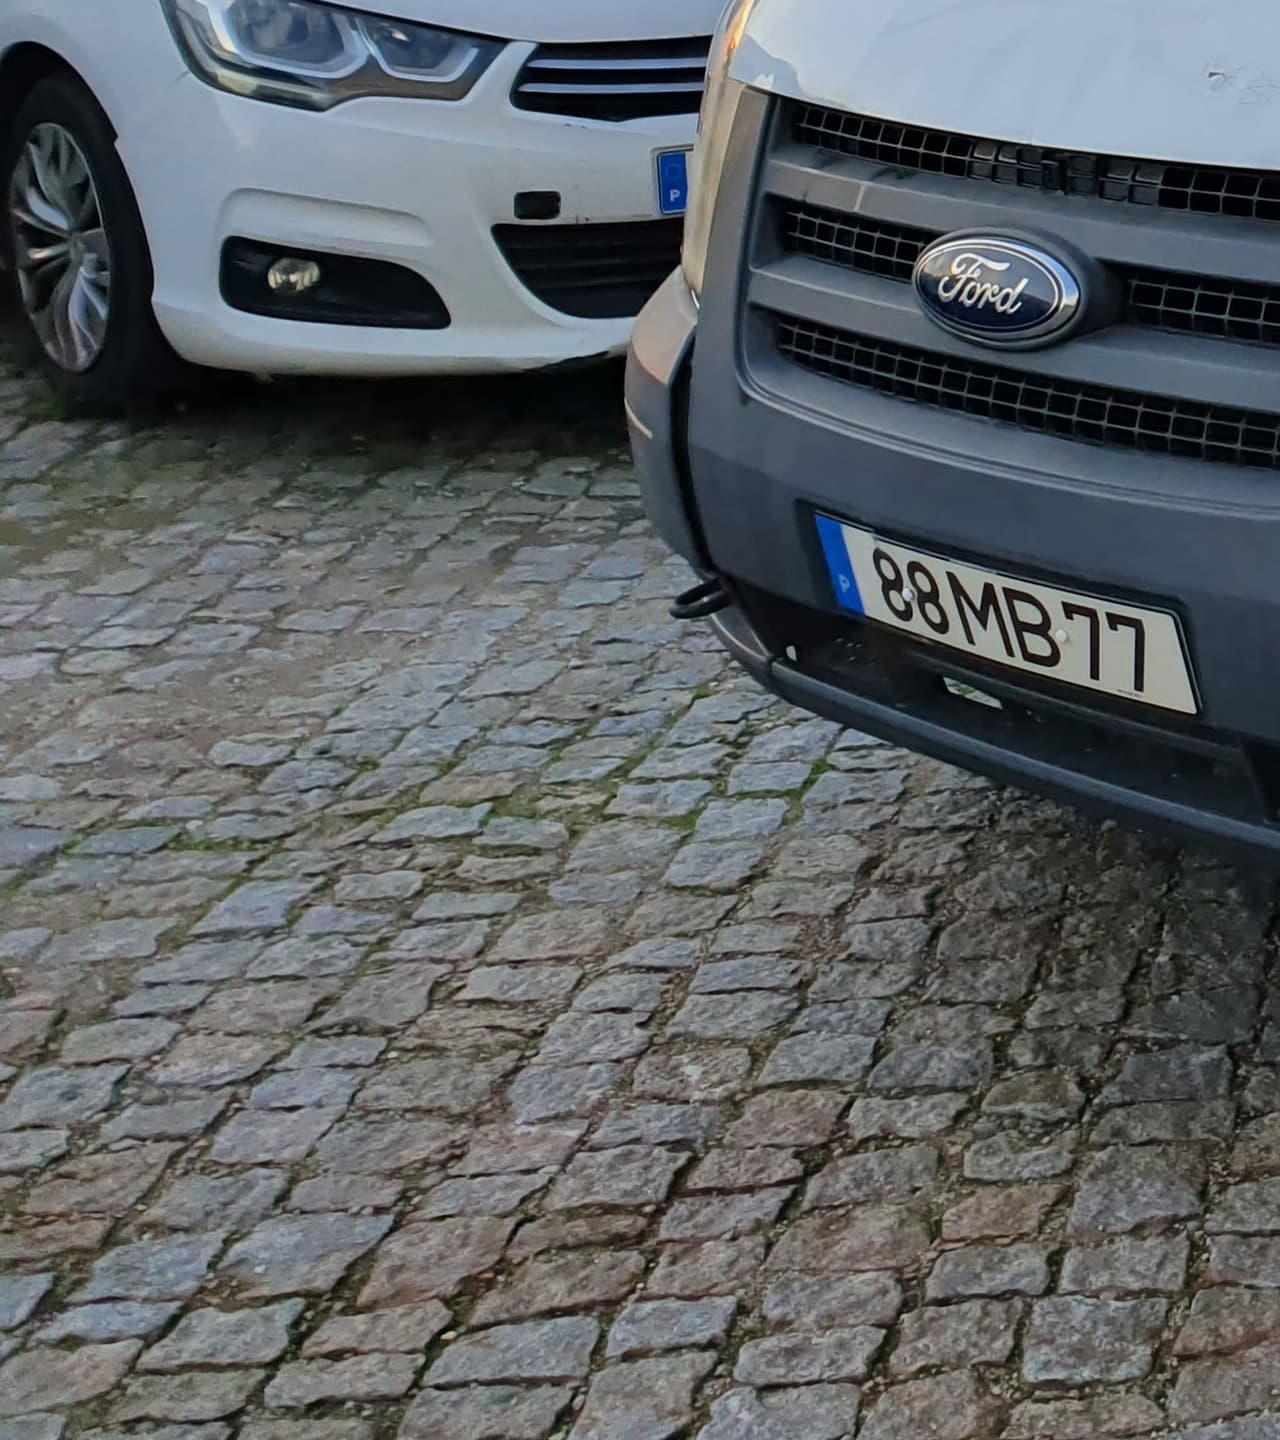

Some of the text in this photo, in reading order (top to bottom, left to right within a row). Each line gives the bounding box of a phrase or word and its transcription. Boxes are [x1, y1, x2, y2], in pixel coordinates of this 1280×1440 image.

[670, 189, 680, 202] P
[938, 253, 1029, 315] Ford
[838, 573, 850, 592] P
[874, 548, 1145, 691] 88MB77
